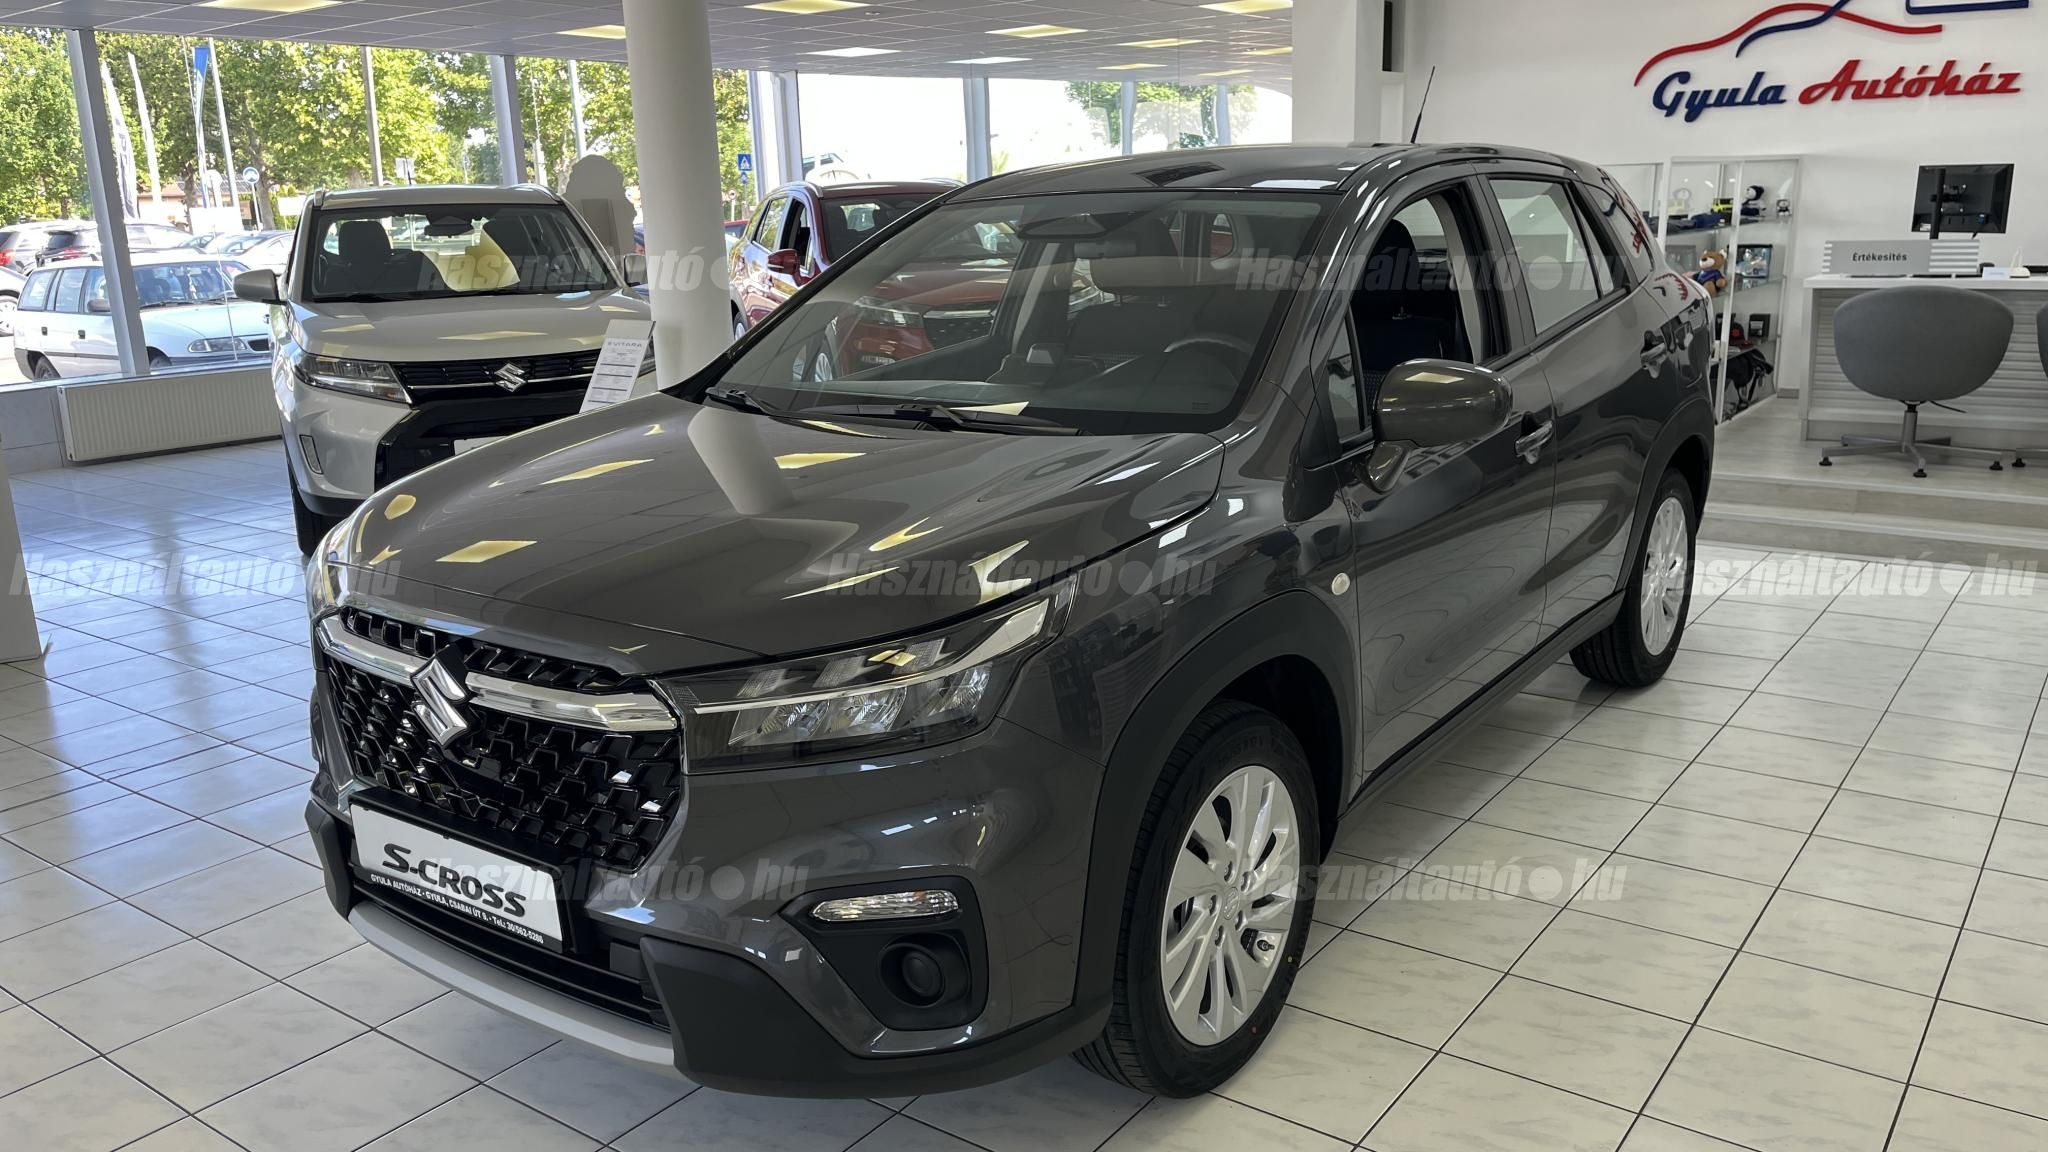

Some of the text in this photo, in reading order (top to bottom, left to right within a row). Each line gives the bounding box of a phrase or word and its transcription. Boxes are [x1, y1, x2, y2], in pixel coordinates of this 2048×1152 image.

[1652, 59, 2021, 123] Gyula Autóház
[1852, 251, 1908, 262] Értékesítés
[371, 873, 392, 887] GYULA
[393, 881, 422, 897] AUTÓHÁZ
[425, 891, 449, 907] GYULA,
[449, 900, 472, 915] CSABAI
[382, 843, 527, 917] S-CROSS
